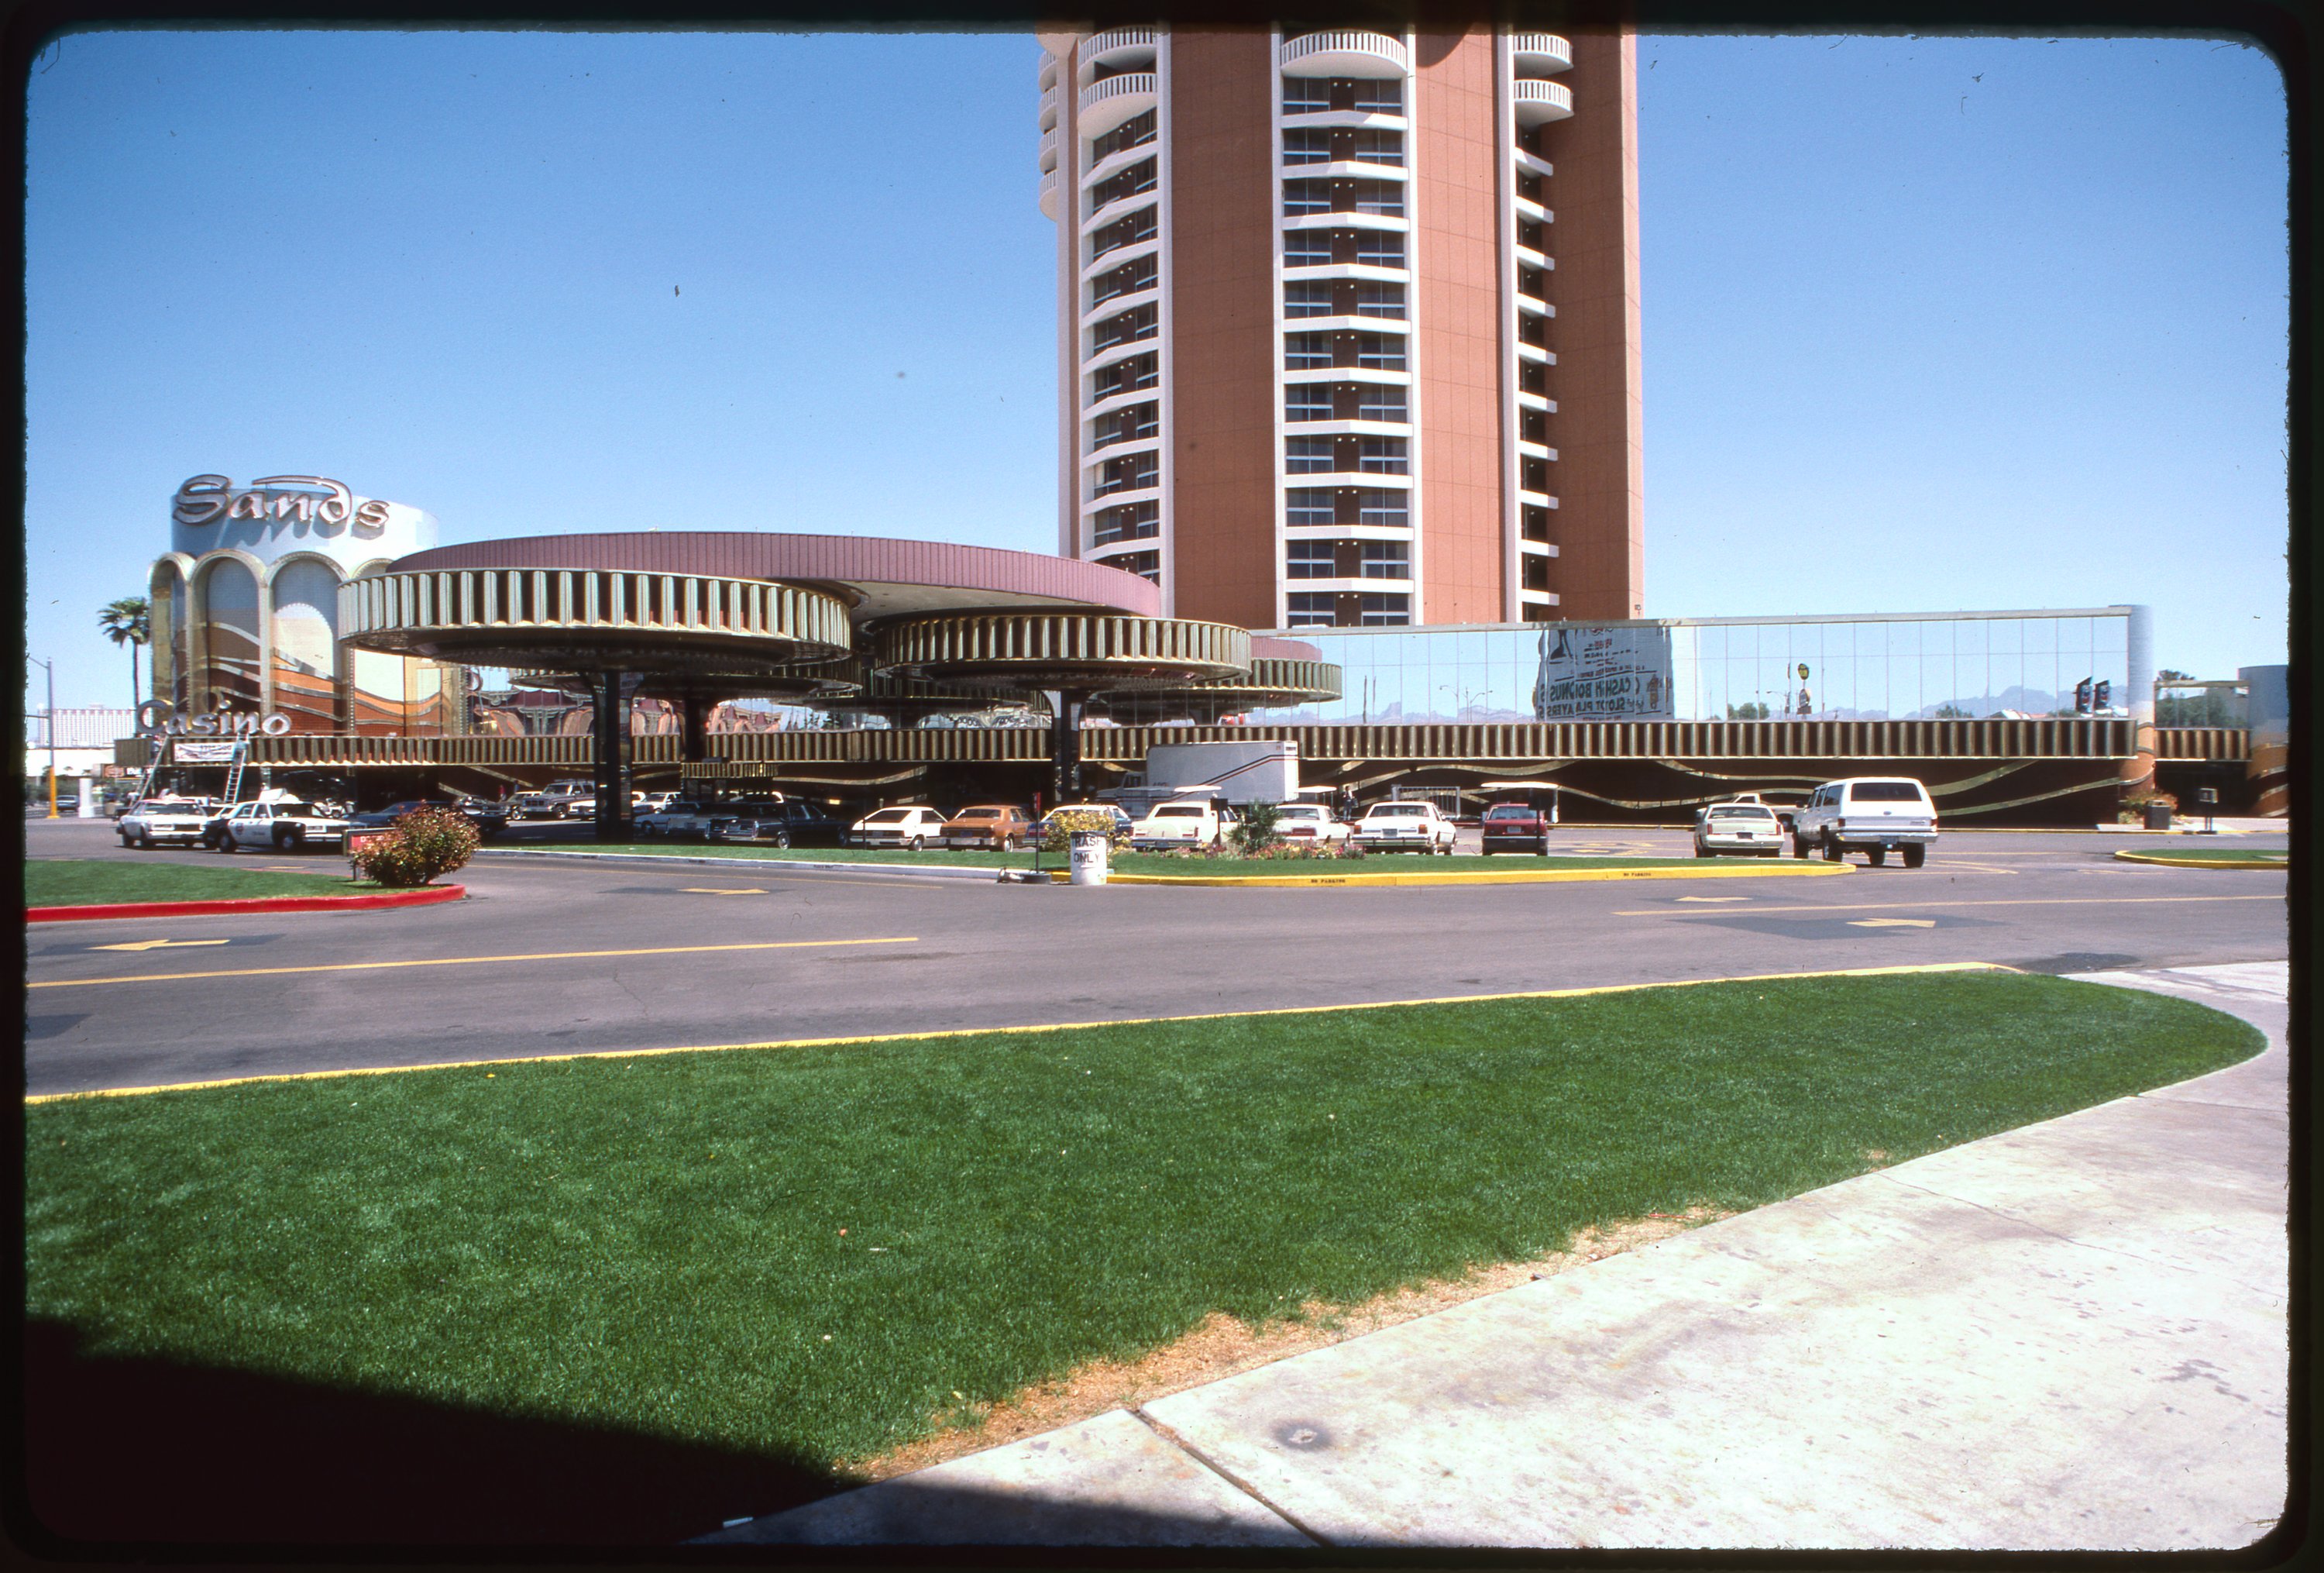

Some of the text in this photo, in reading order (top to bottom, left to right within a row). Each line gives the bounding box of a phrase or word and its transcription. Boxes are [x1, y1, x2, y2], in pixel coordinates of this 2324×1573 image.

[172, 473, 390, 526] Sands
[136, 699, 291, 735] Casino
[1074, 852, 1100, 863] ONLY
